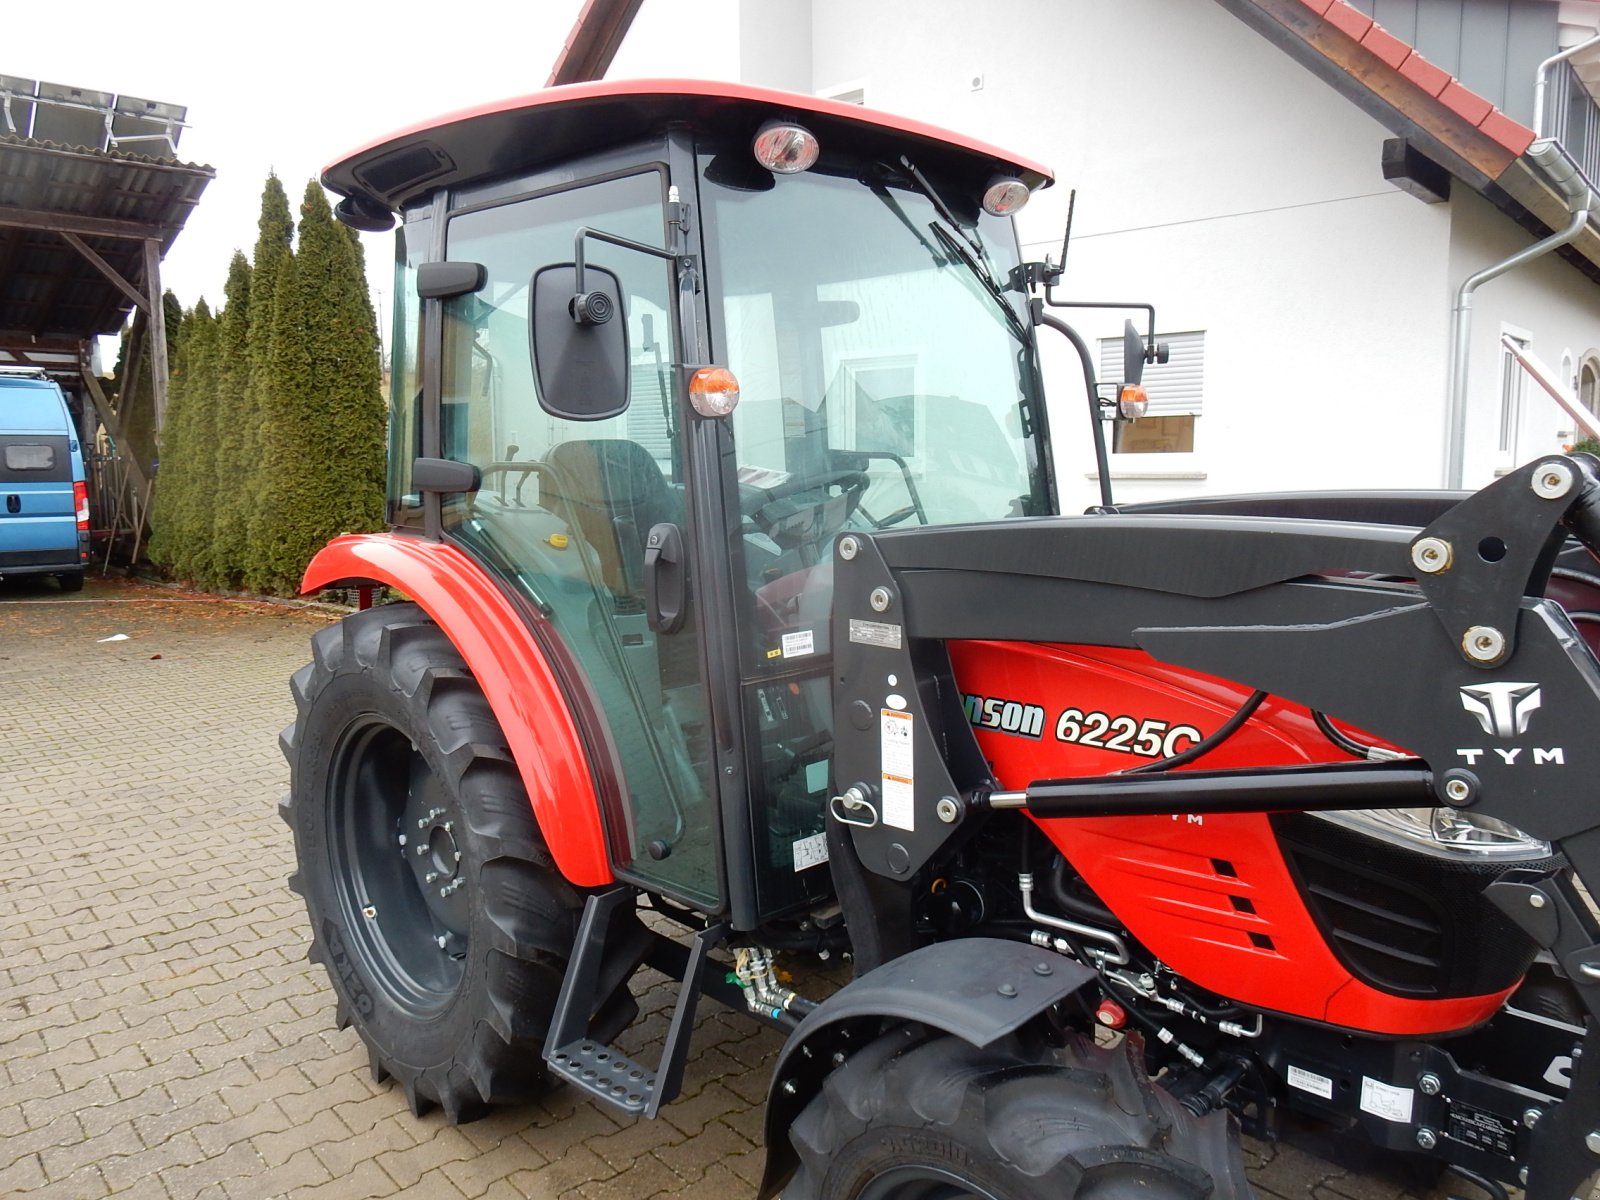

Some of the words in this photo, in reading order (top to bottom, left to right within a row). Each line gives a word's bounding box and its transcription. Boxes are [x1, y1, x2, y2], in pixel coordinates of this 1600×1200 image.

[963, 694, 1045, 738] nson
[1055, 707, 1202, 760] 6225C
[1456, 747, 1565, 765] TYM
